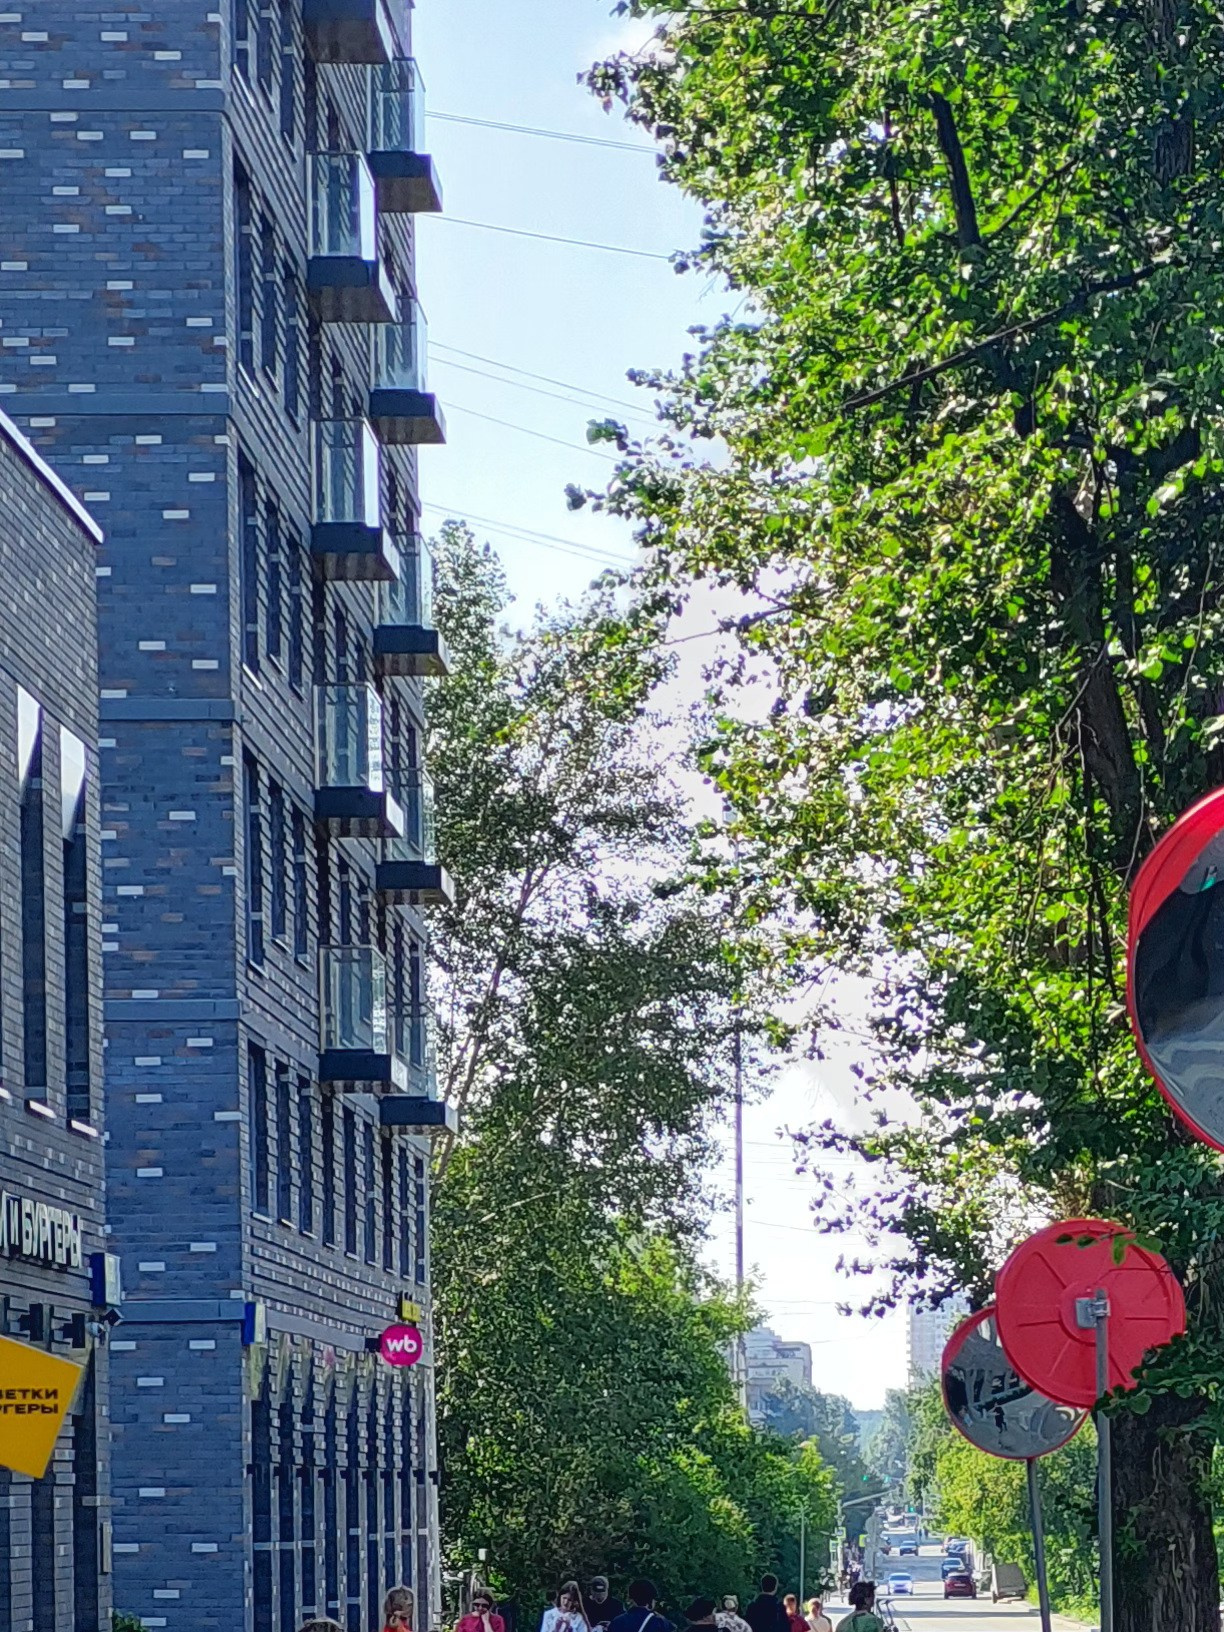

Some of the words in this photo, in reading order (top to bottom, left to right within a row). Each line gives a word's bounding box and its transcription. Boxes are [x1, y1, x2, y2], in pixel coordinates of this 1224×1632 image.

[21, 1197, 82, 1269] БУРГЕРЫ
[386, 1334, 417, 1353] wb
[0, 1388, 58, 1400] ЕТКИ
[0, 1403, 59, 1415] ГЕРЫ
